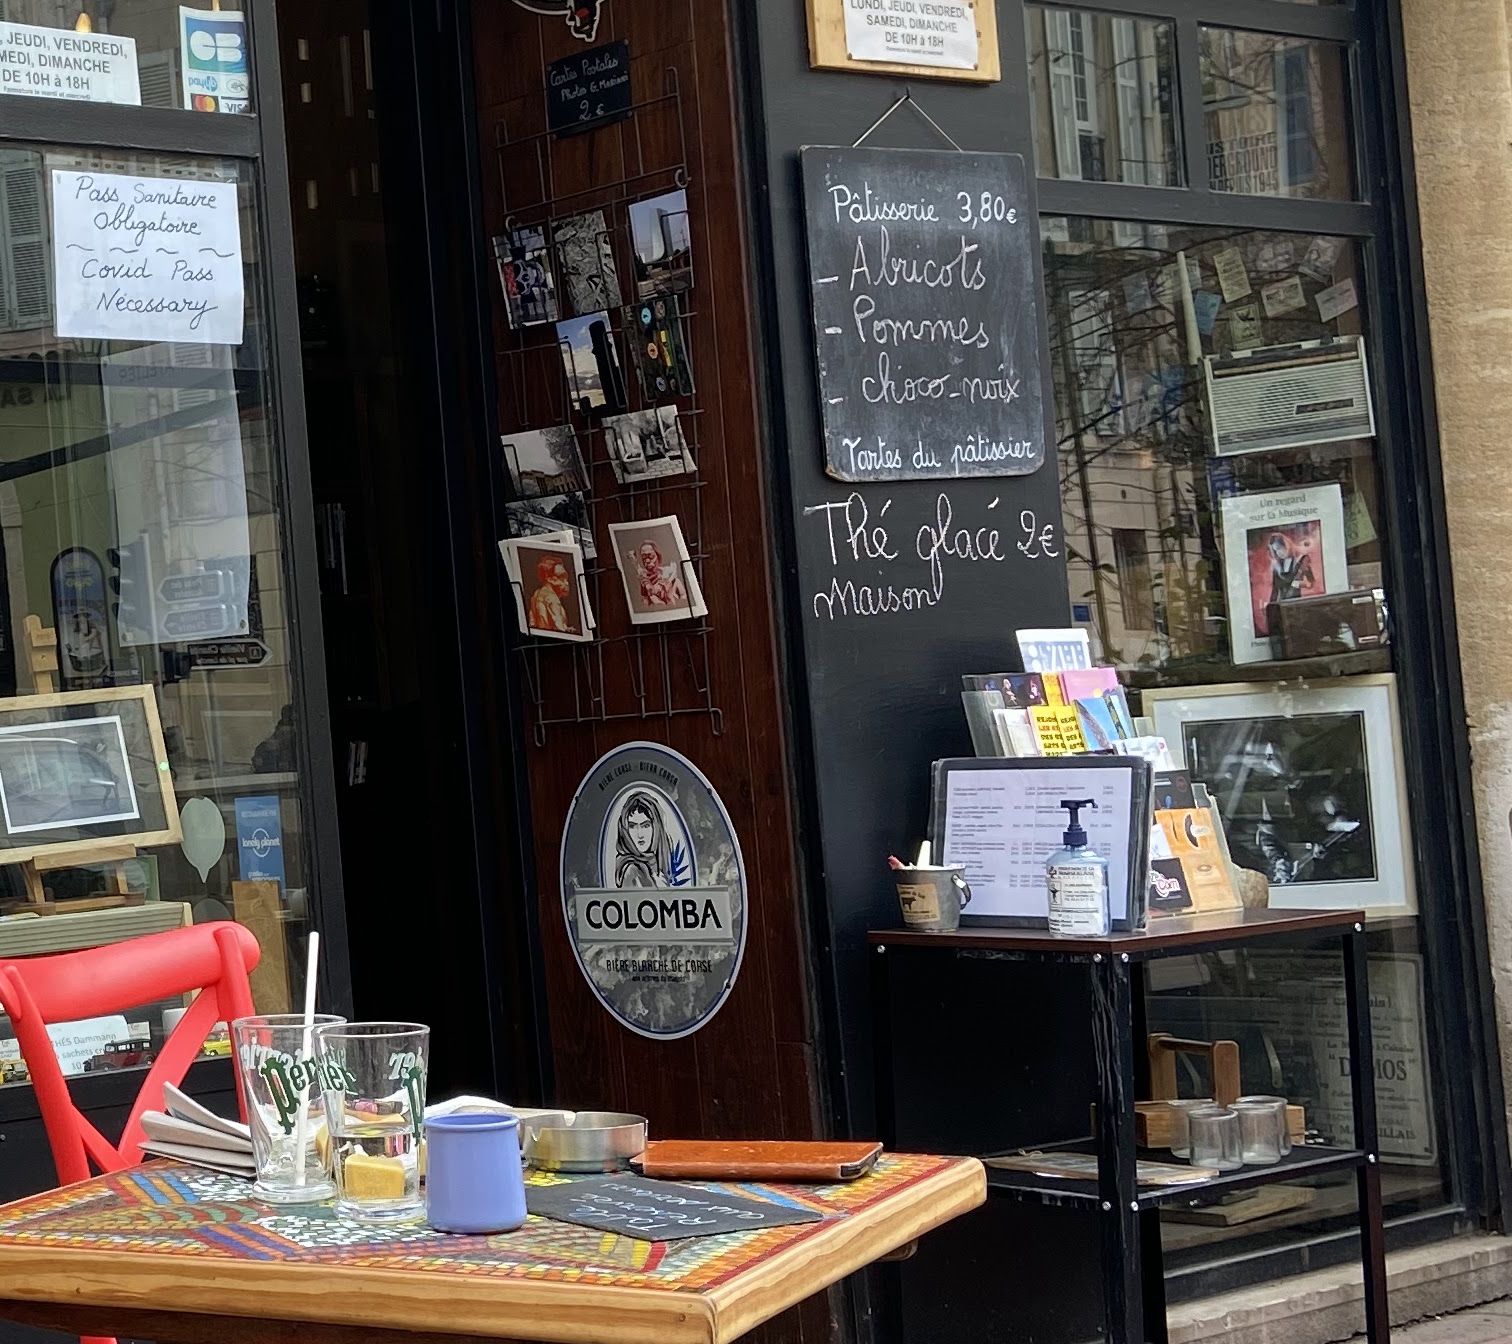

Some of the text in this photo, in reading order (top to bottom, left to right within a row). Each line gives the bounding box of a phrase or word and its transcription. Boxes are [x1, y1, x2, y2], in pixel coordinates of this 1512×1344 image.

[909, 19, 958, 33] DIMANCHE
[919, 4, 968, 20] VENDREDI,
[7, 31, 51, 51] JEUDI,
[53, 36, 128, 59] VENDREDI,
[190, 31, 242, 62] CB
[885, 33, 899, 44] DE
[901, 34, 918, 46] 10H
[927, 36, 944, 47] 18H
[38, 53, 110, 74] DIMANCHE
[2, 70, 90, 90] DE 10H à 18H
[75, 176, 217, 209] Pass Sanitaire
[828, 181, 1018, 230] Pâtisserie 3,80€
[94, 203, 201, 246] Obligatoire
[82, 259, 214, 282] Covid Pass
[849, 226, 987, 291] Abricots
[854, 295, 990, 349] Pommes
[843, 434, 1036, 475] Tartes du pâtissier
[804, 491, 899, 564] Thé
[916, 493, 1005, 603] glacé
[242, 837, 280, 850] lonely planet
[586, 899, 722, 929] COLOMBA
[606, 958, 629, 972] BIÈRE
[671, 959, 683, 972] DE
[685, 959, 712, 972] CORSE
